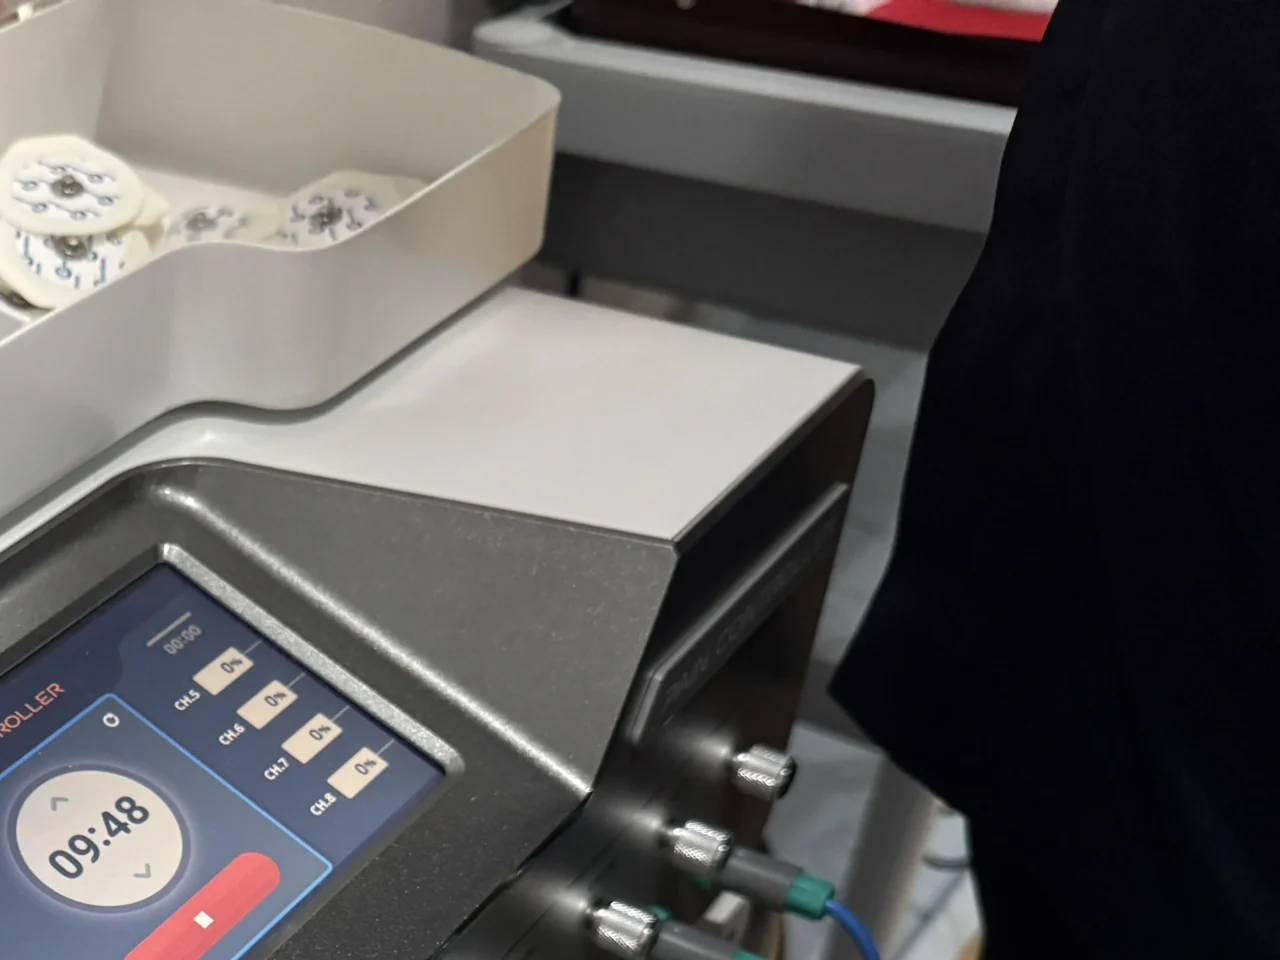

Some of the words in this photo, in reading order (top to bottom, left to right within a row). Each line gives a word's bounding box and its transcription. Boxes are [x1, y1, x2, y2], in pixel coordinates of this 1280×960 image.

[163, 624, 201, 654] 00:00
[220, 657, 243, 673] 0%
[174, 689, 200, 710] CH.5
[264, 690, 287, 706] 0%
[218, 723, 245, 745] CH.6
[308, 723, 331, 740] 0%
[263, 757, 289, 780] CH.7
[354, 757, 377, 774] 0%
[309, 792, 336, 815] CH.8
[48, 796, 149, 878] 09:48
